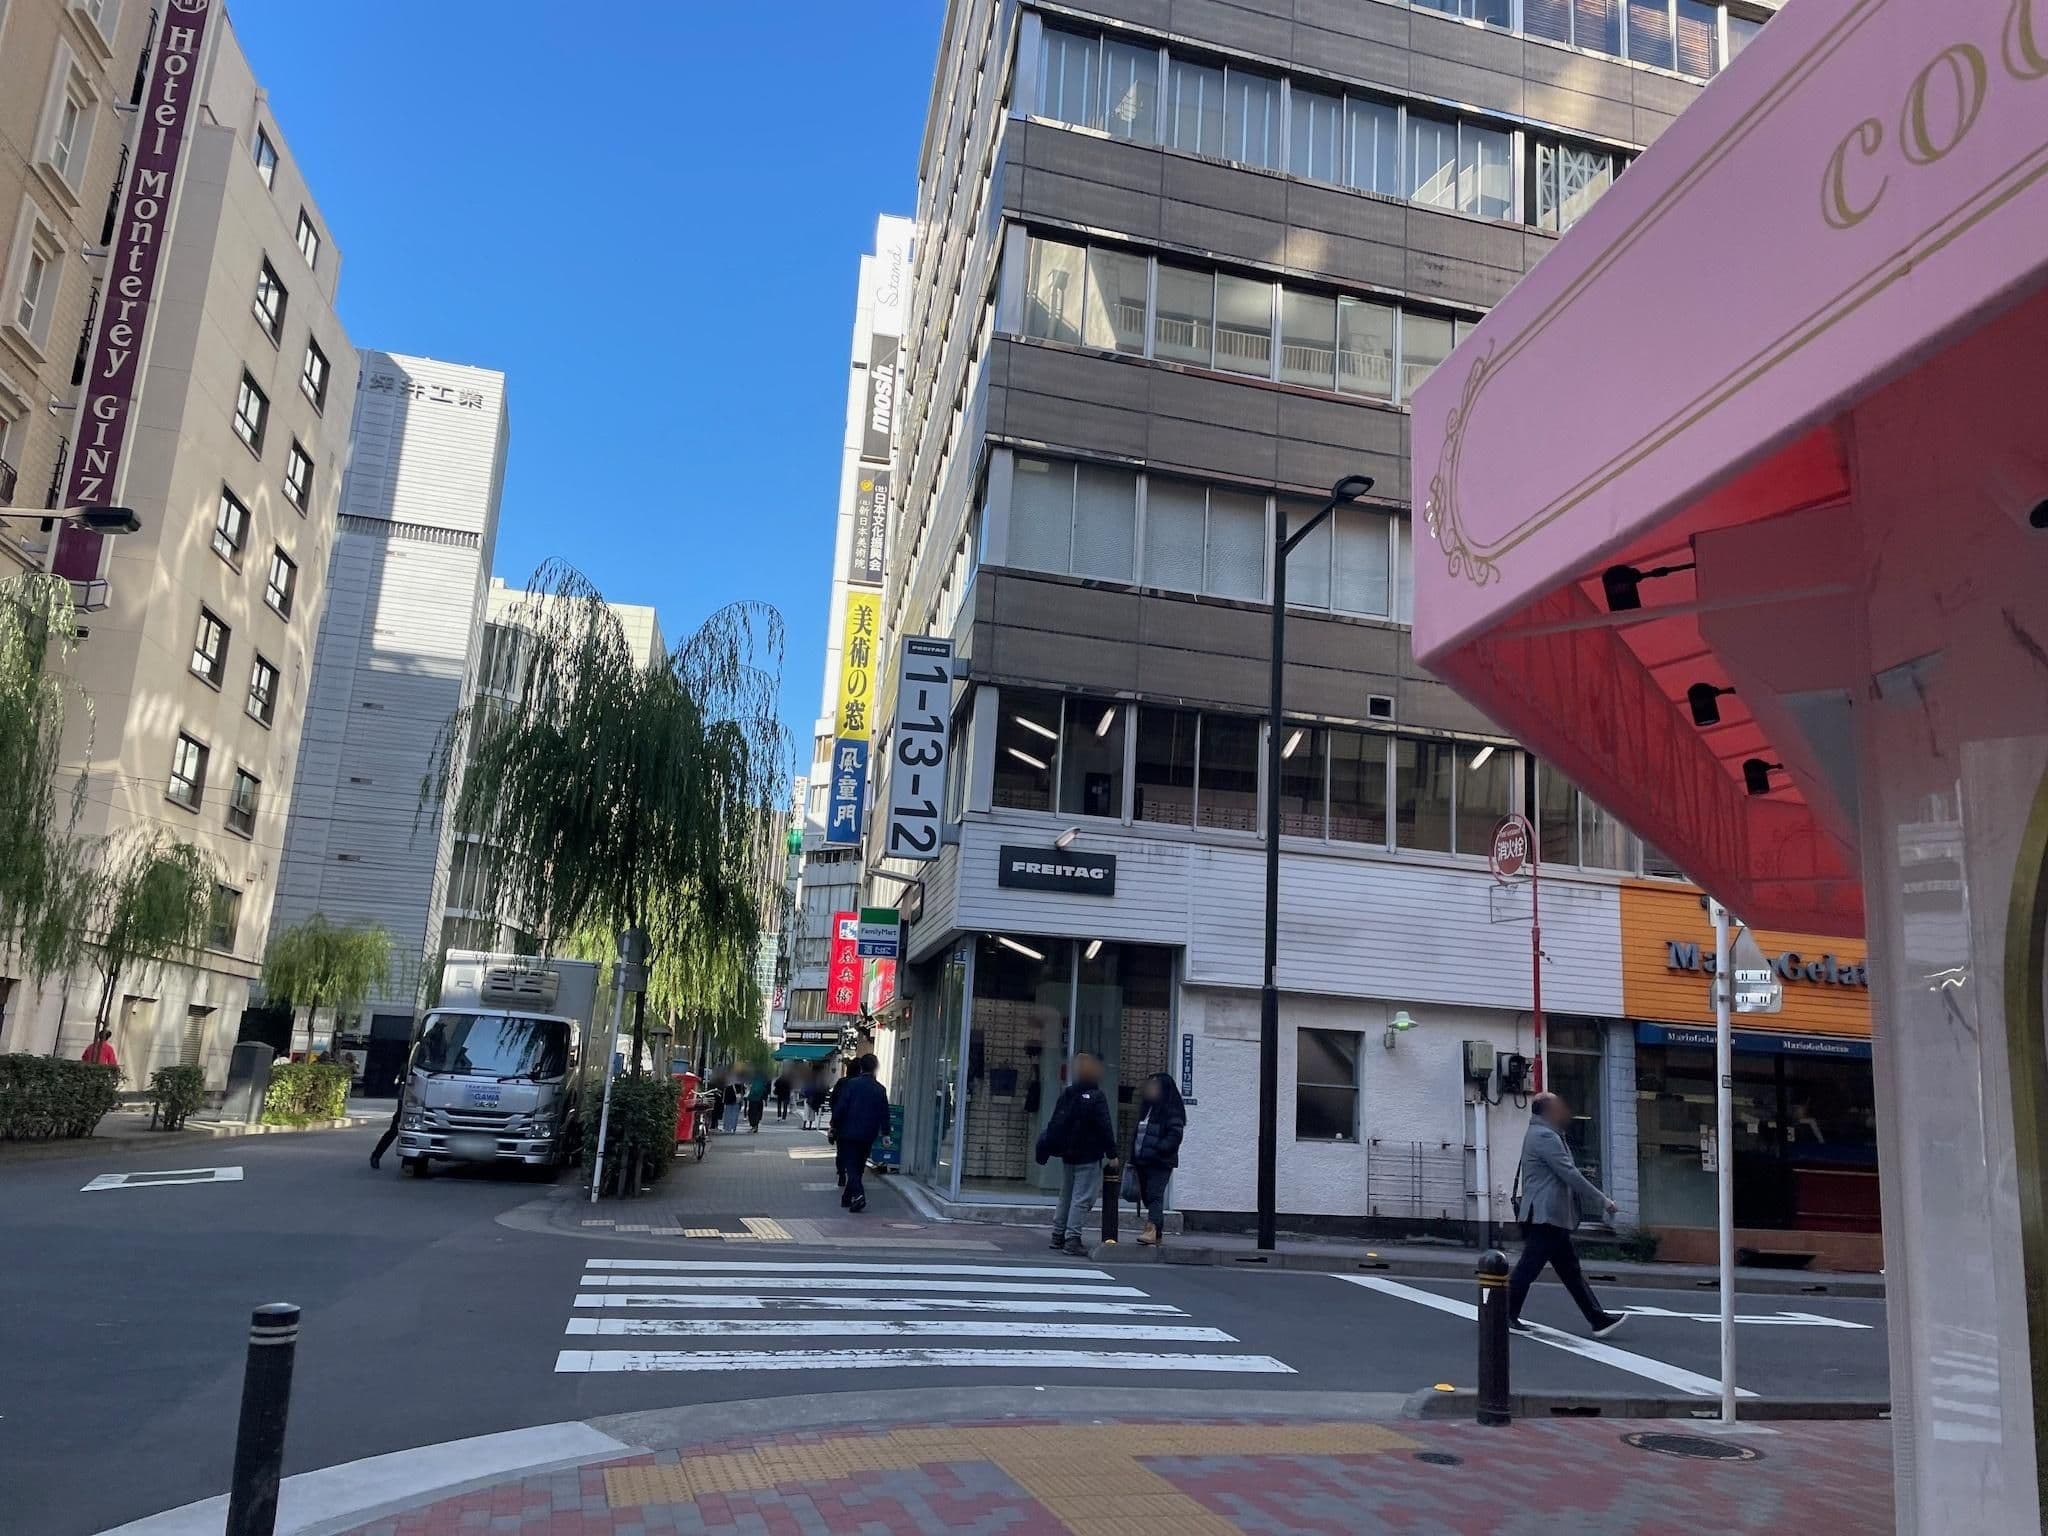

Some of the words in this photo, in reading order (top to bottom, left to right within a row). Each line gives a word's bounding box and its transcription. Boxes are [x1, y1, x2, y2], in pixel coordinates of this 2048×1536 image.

[153, 25, 196, 155] Hotel
[103, 168, 168, 378] Monterey
[69, 395, 120, 530] GINZ
[843, 604, 873, 731] 美術の窓
[911, 645, 947, 653] FREITAG
[891, 665, 949, 852] 1-13-12
[1498, 836, 1524, 861] 消火栓
[861, 927, 897, 936] FamilyMart
